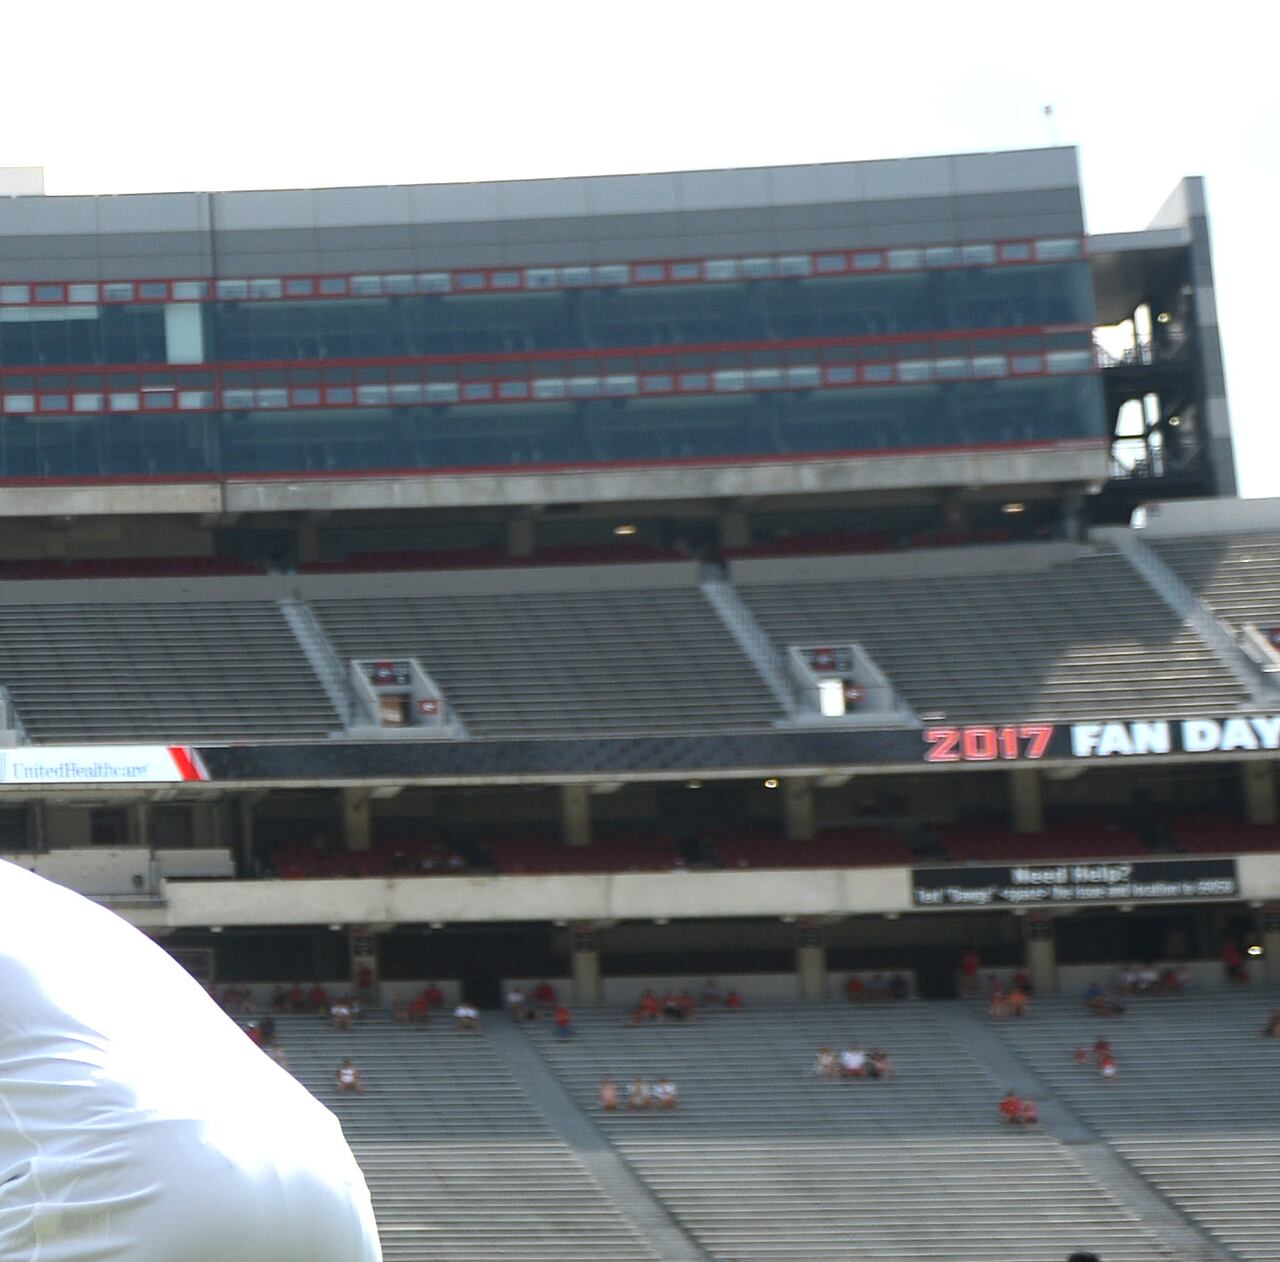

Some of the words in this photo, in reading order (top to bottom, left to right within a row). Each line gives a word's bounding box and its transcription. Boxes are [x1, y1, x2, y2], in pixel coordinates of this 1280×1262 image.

[923, 724, 1054, 762] 2017
[1071, 720, 1171, 757] FAN
[1182, 716, 1280, 753] DAY
[12, 762, 148, 779] UnitedHealthcare
